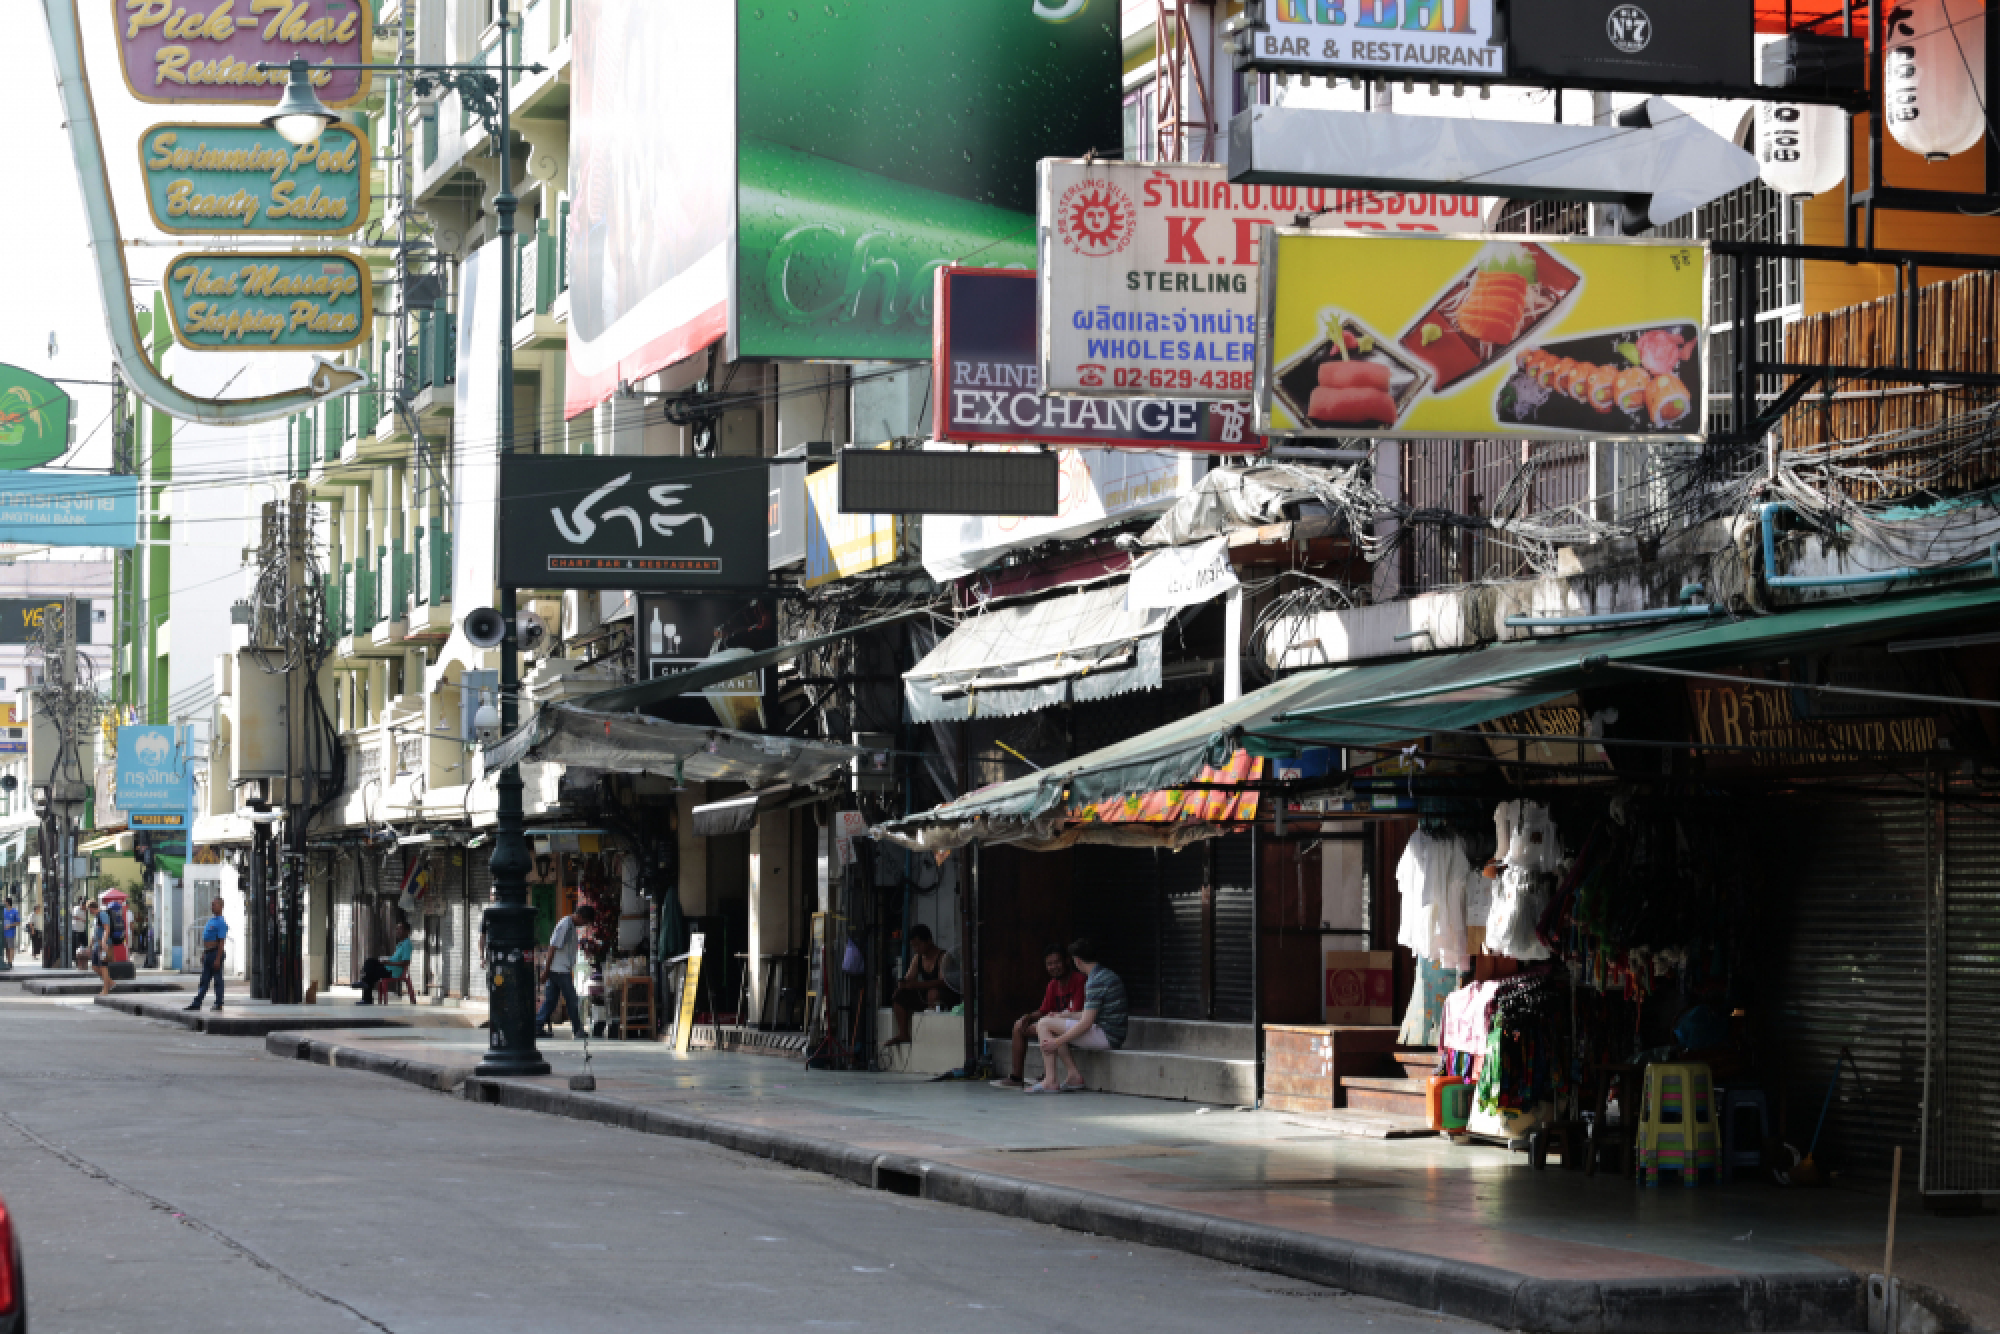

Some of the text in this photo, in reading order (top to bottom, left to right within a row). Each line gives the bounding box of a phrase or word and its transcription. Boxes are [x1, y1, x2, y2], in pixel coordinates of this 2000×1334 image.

[126, 0, 357, 43] Pick-Thai
[1264, 35, 1496, 68] BAR & RESTAURANT
[148, 132, 357, 183] Swimming Pool
[166, 179, 348, 227] Beauty Salon
[174, 264, 358, 305] Thai Massage
[1126, 271, 1247, 294] STERLING
[184, 300, 358, 342] Shopping Plaza
[952, 389, 1198, 434] EXCHANGE
[53, 513, 87, 525] BANK
[551, 559, 591, 568] CHART
[597, 559, 620, 568] BAR
[639, 559, 718, 569] RESTAURANT
